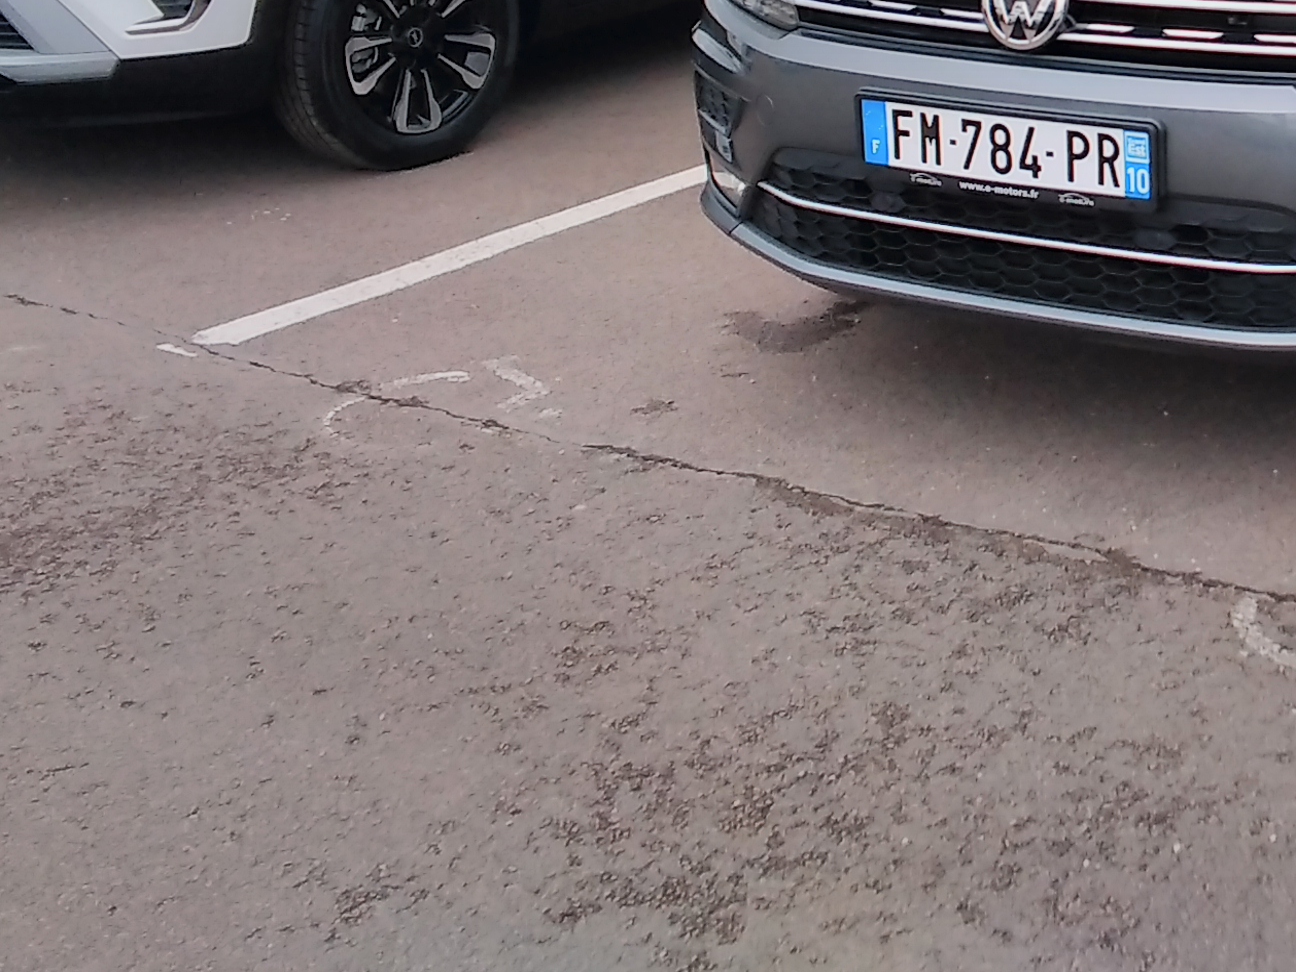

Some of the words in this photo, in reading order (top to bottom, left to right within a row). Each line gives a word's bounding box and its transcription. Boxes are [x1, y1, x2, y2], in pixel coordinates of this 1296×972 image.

[872, 139, 882, 154] F
[891, 108, 1121, 188] FM-784-PR
[958, 180, 1039, 199] www.e-motors.fr
[1127, 166, 1150, 195] 10
